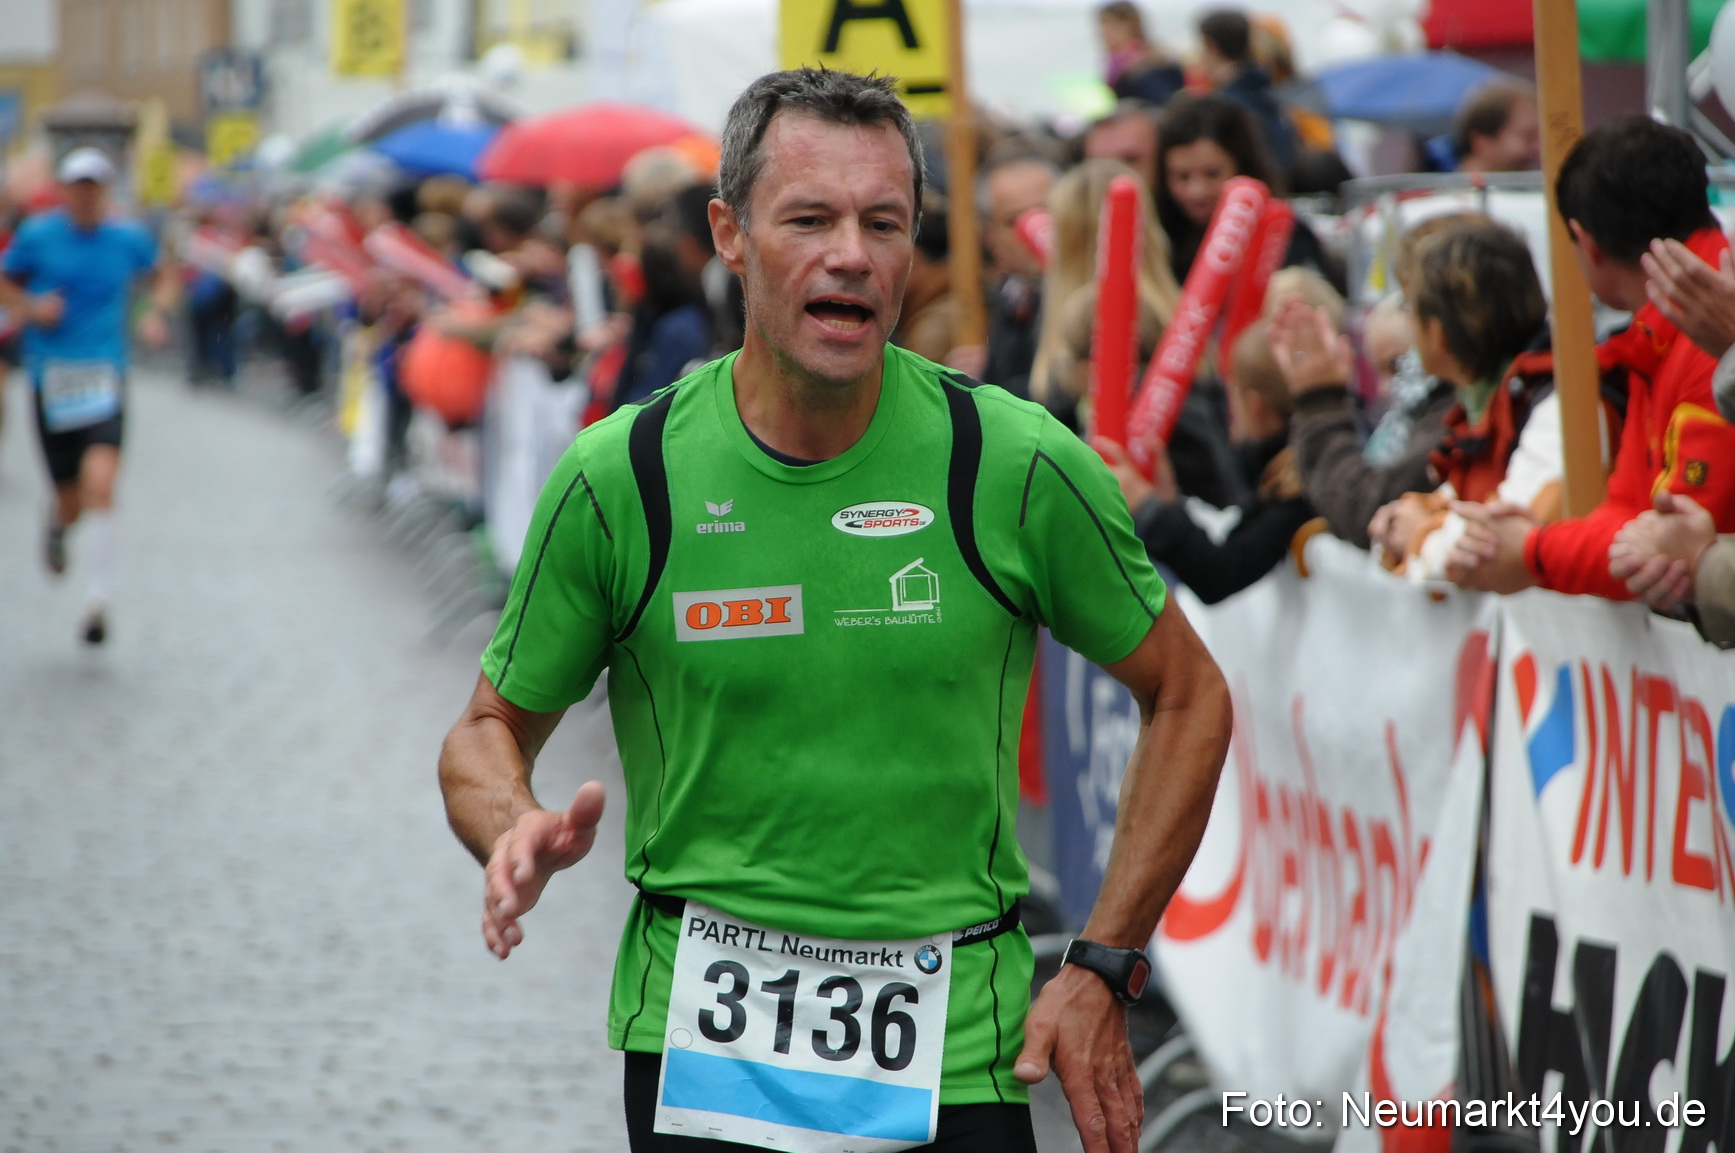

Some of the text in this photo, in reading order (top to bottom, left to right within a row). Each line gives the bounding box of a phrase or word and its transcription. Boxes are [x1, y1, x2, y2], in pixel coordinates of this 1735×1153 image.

[824, 0, 919, 52] A
[840, 508, 904, 519] SYNERGY
[863, 518, 919, 528] SPORTS
[696, 520, 746, 534] erima
[686, 597, 792, 630] OBI
[885, 613, 936, 625] BAUHÜTTE
[687, 917, 904, 968] PARTL Neumarkt
[698, 960, 919, 1071] 3136
